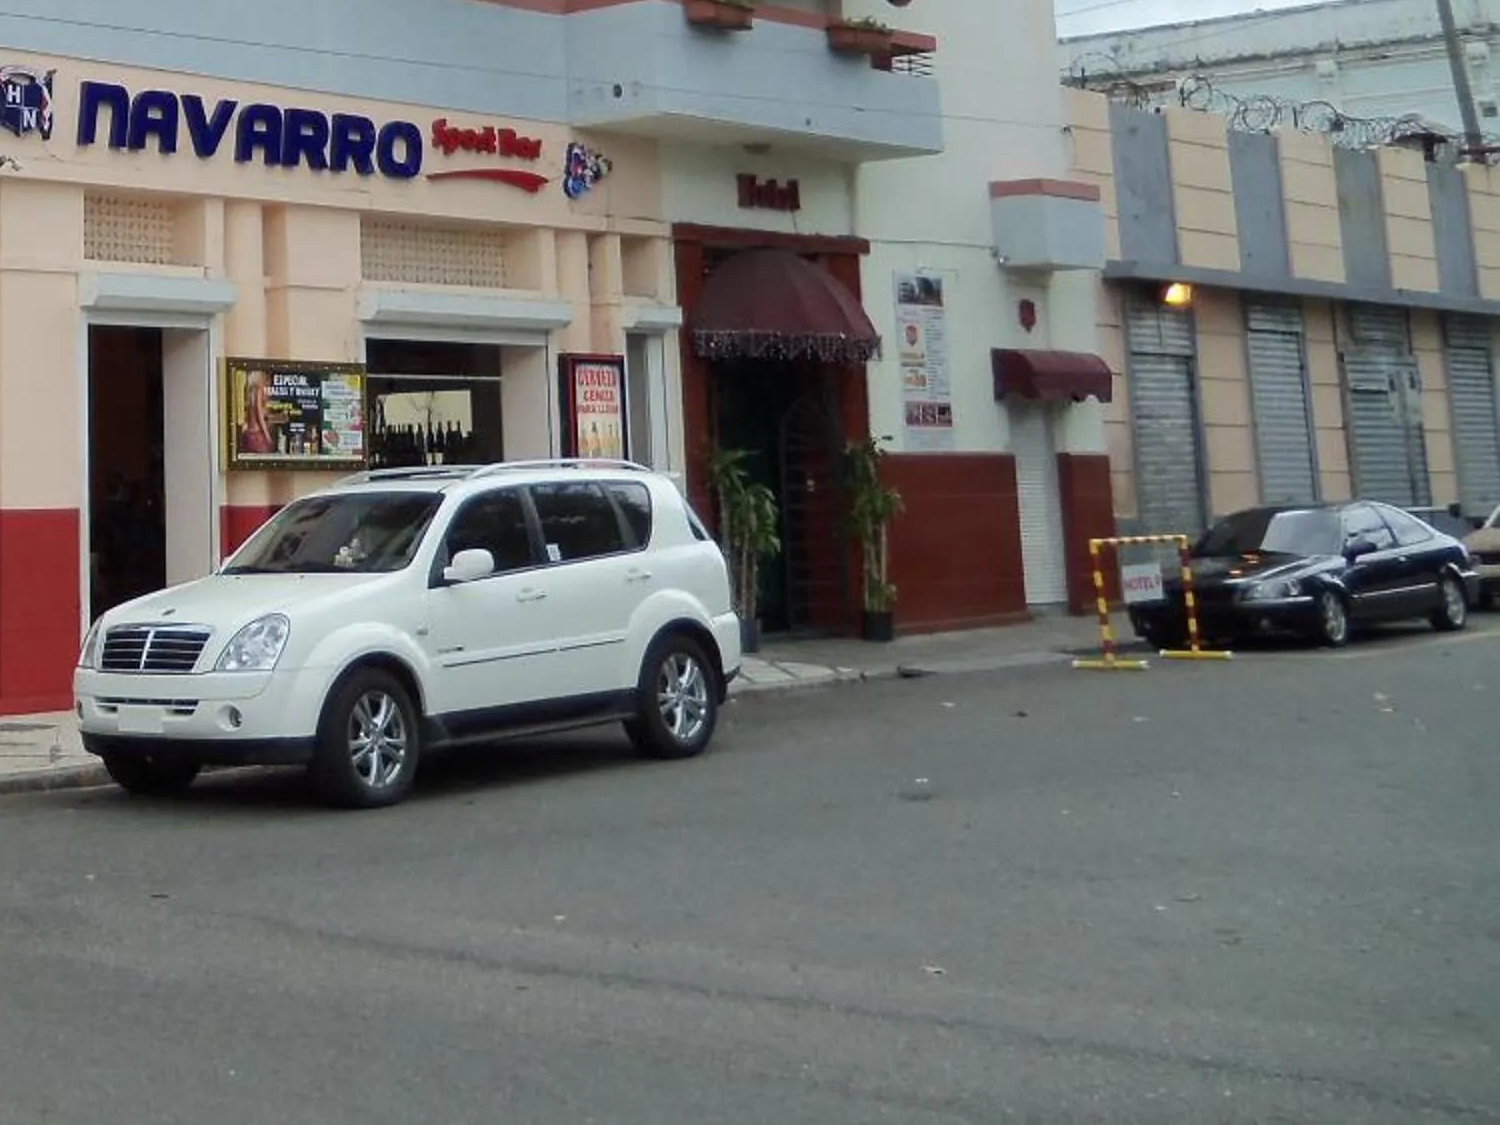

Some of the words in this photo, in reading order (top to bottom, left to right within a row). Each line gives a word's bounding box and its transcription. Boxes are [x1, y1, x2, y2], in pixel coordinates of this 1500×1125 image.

[7, 84, 21, 104] H
[23, 109, 37, 129] N
[76, 80, 423, 179] NAVARRO
[432, 118, 496, 156] Sport
[497, 128, 543, 161] Bar
[736, 173, 801, 212] Hotel
